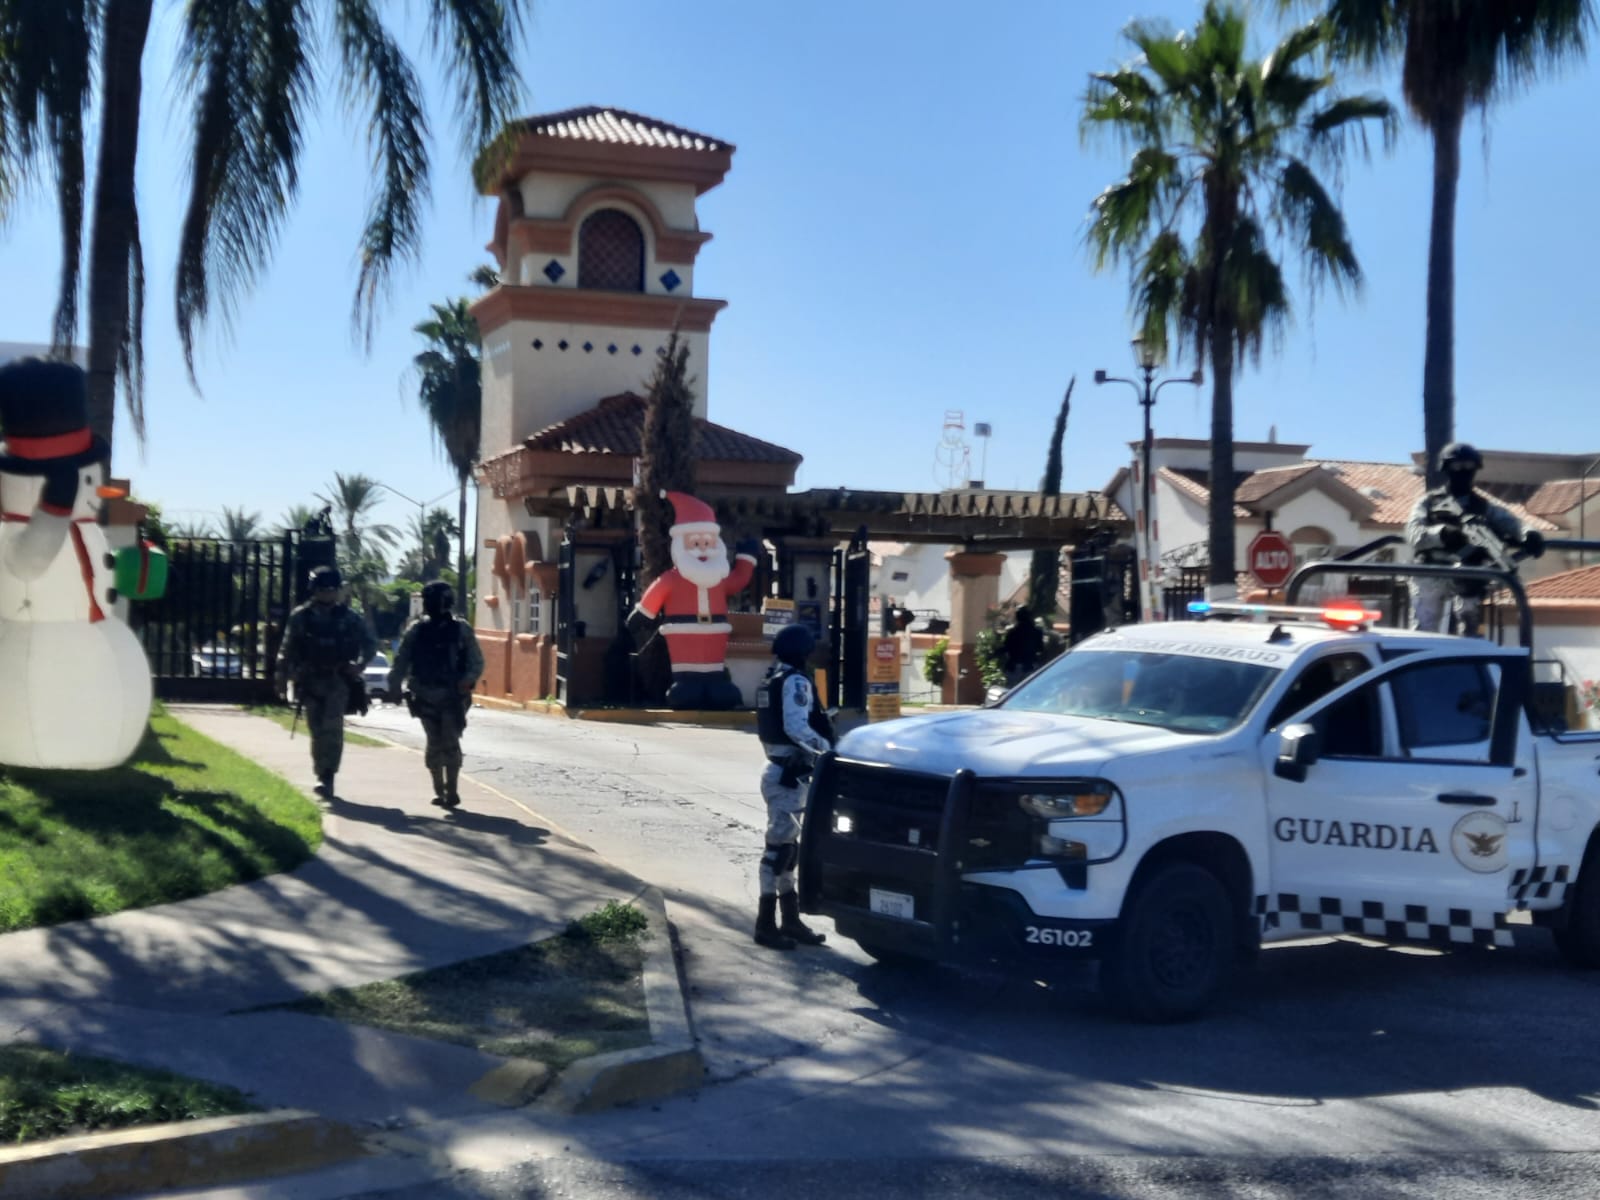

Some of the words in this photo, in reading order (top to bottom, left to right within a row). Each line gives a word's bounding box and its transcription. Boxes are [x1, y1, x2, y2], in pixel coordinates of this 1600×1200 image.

[1255, 550, 1289, 570] ALTO
[1274, 816, 1440, 854] GUARDIA
[1025, 926, 1093, 947] 26102
